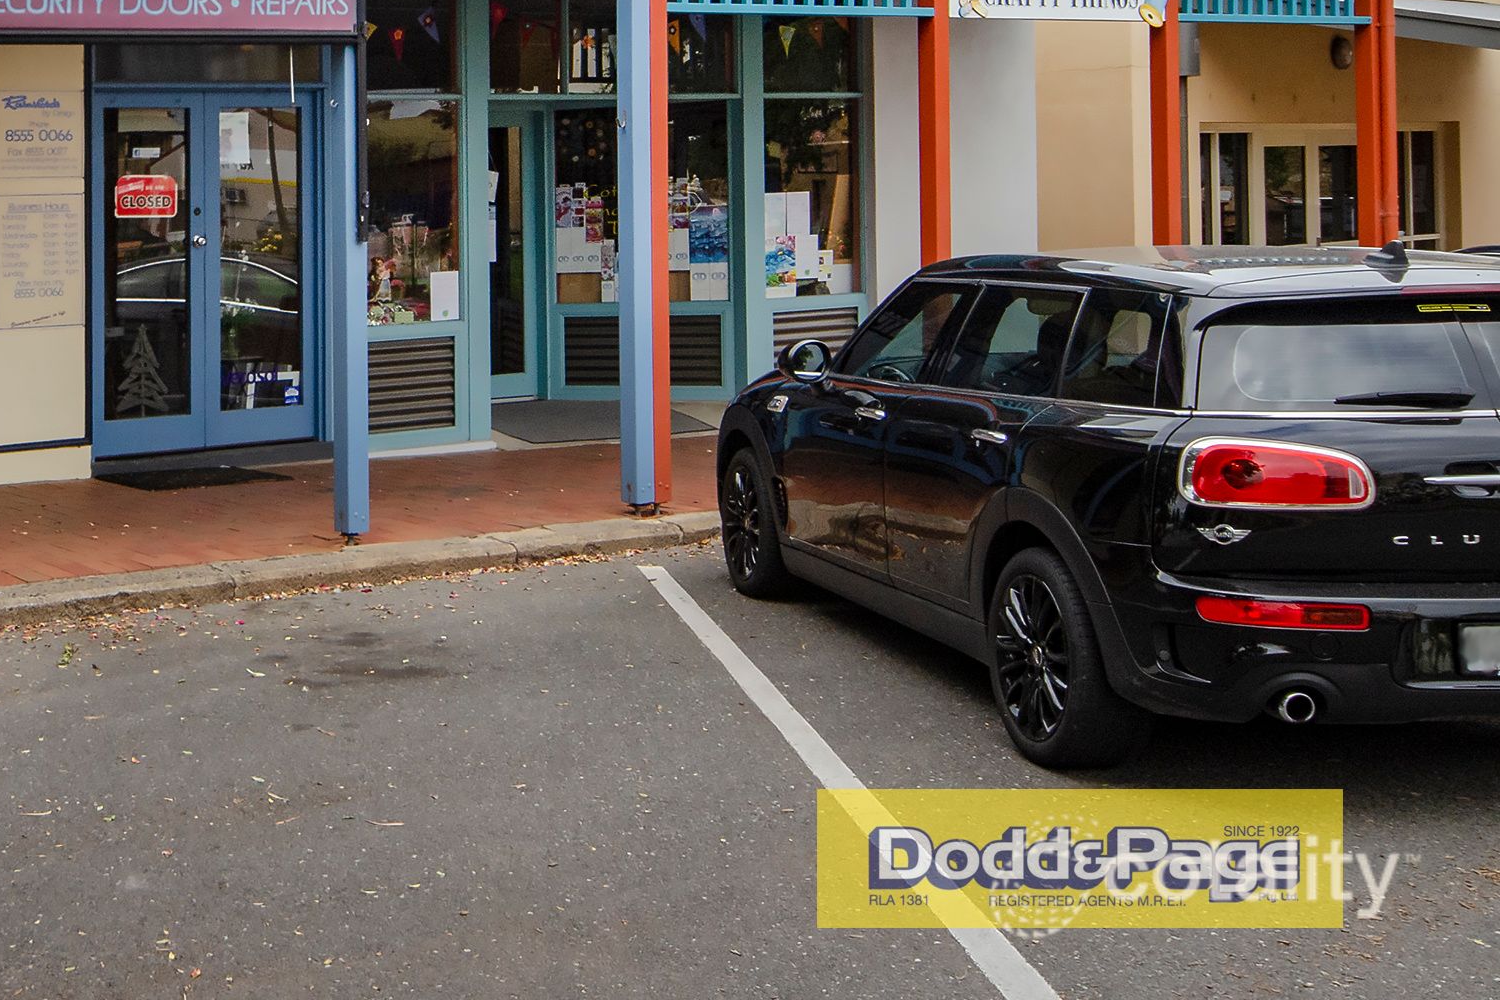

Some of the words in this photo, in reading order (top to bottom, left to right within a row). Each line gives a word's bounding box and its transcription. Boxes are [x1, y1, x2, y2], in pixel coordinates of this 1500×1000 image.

[5, 129, 34, 142] 8555
[39, 129, 73, 142] 0066
[120, 195, 172, 208] CLOSED
[14, 288, 36, 299] 8555
[38, 287, 64, 298] 0066
